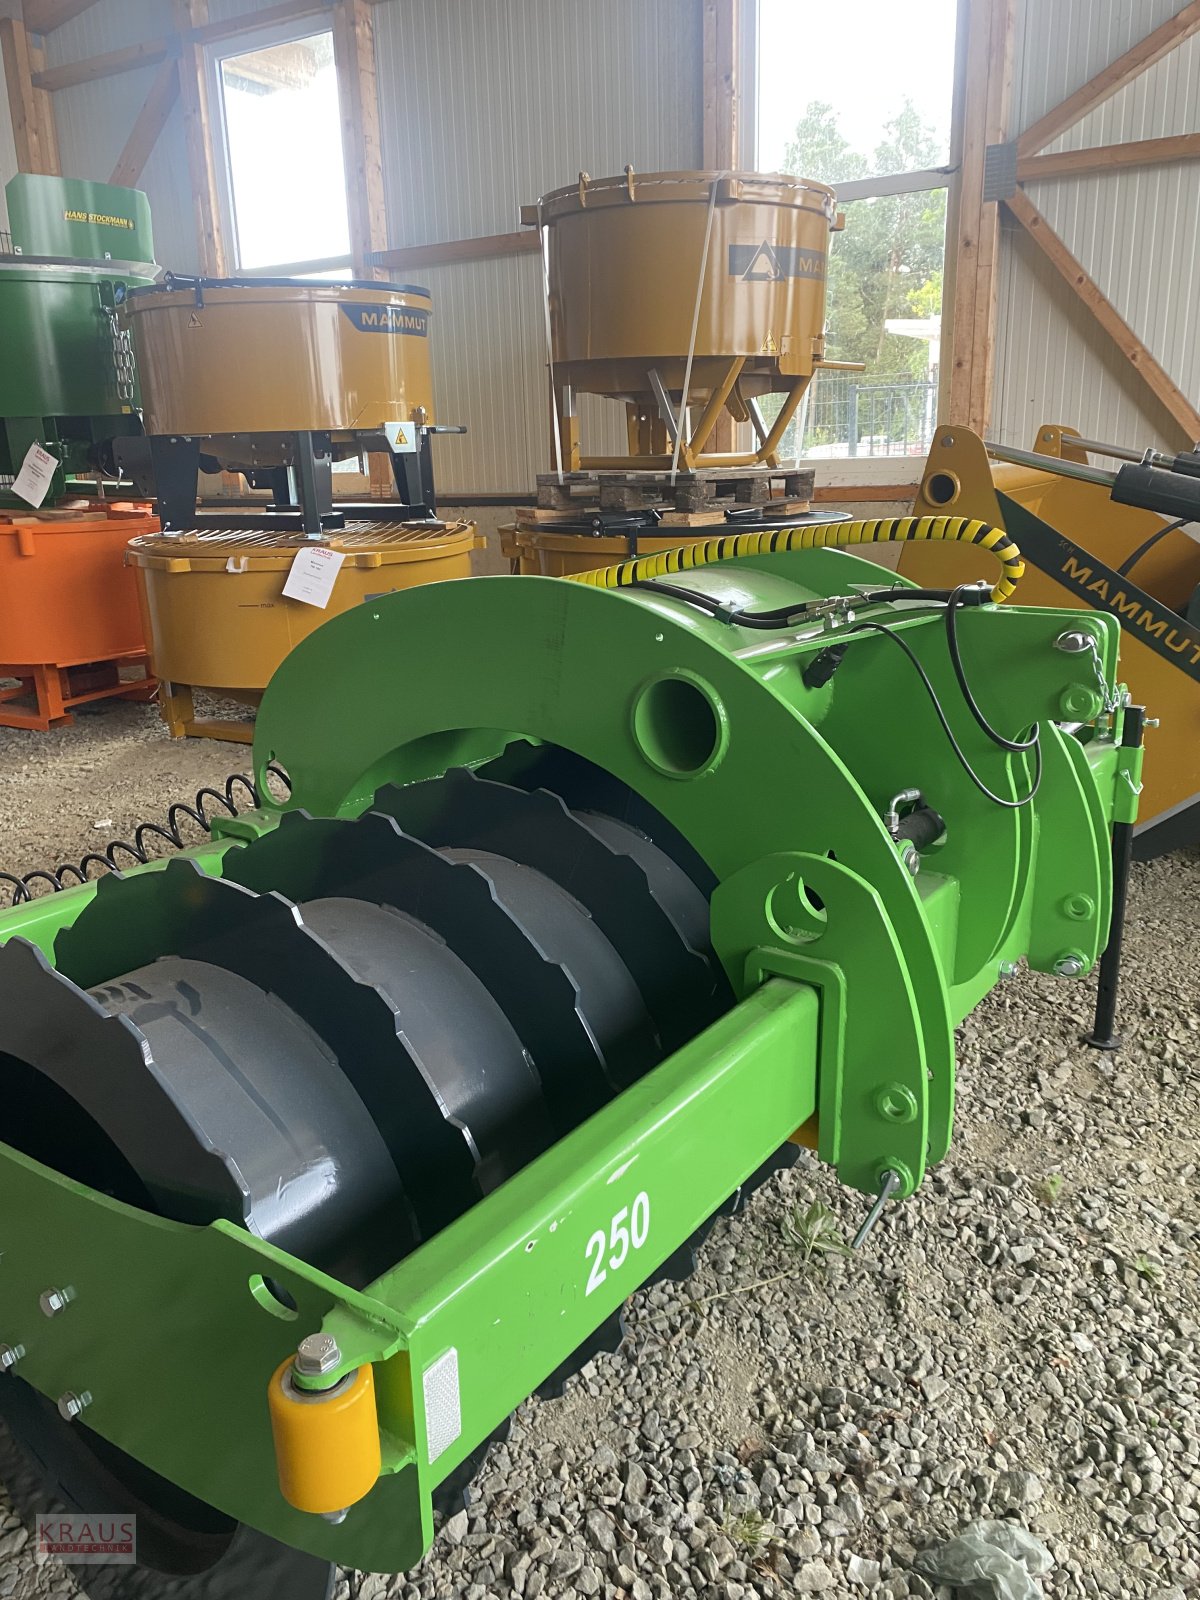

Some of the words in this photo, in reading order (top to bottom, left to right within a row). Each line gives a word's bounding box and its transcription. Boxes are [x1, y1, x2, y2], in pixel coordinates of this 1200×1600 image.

[64, 210, 88, 221] HANS
[88, 213, 129, 226] STOCKMANN
[799, 256, 824, 273] MA
[361, 312, 426, 330] MAMMUT
[1061, 556, 1200, 664] MAMMUT
[585, 1190, 650, 1297] 250
